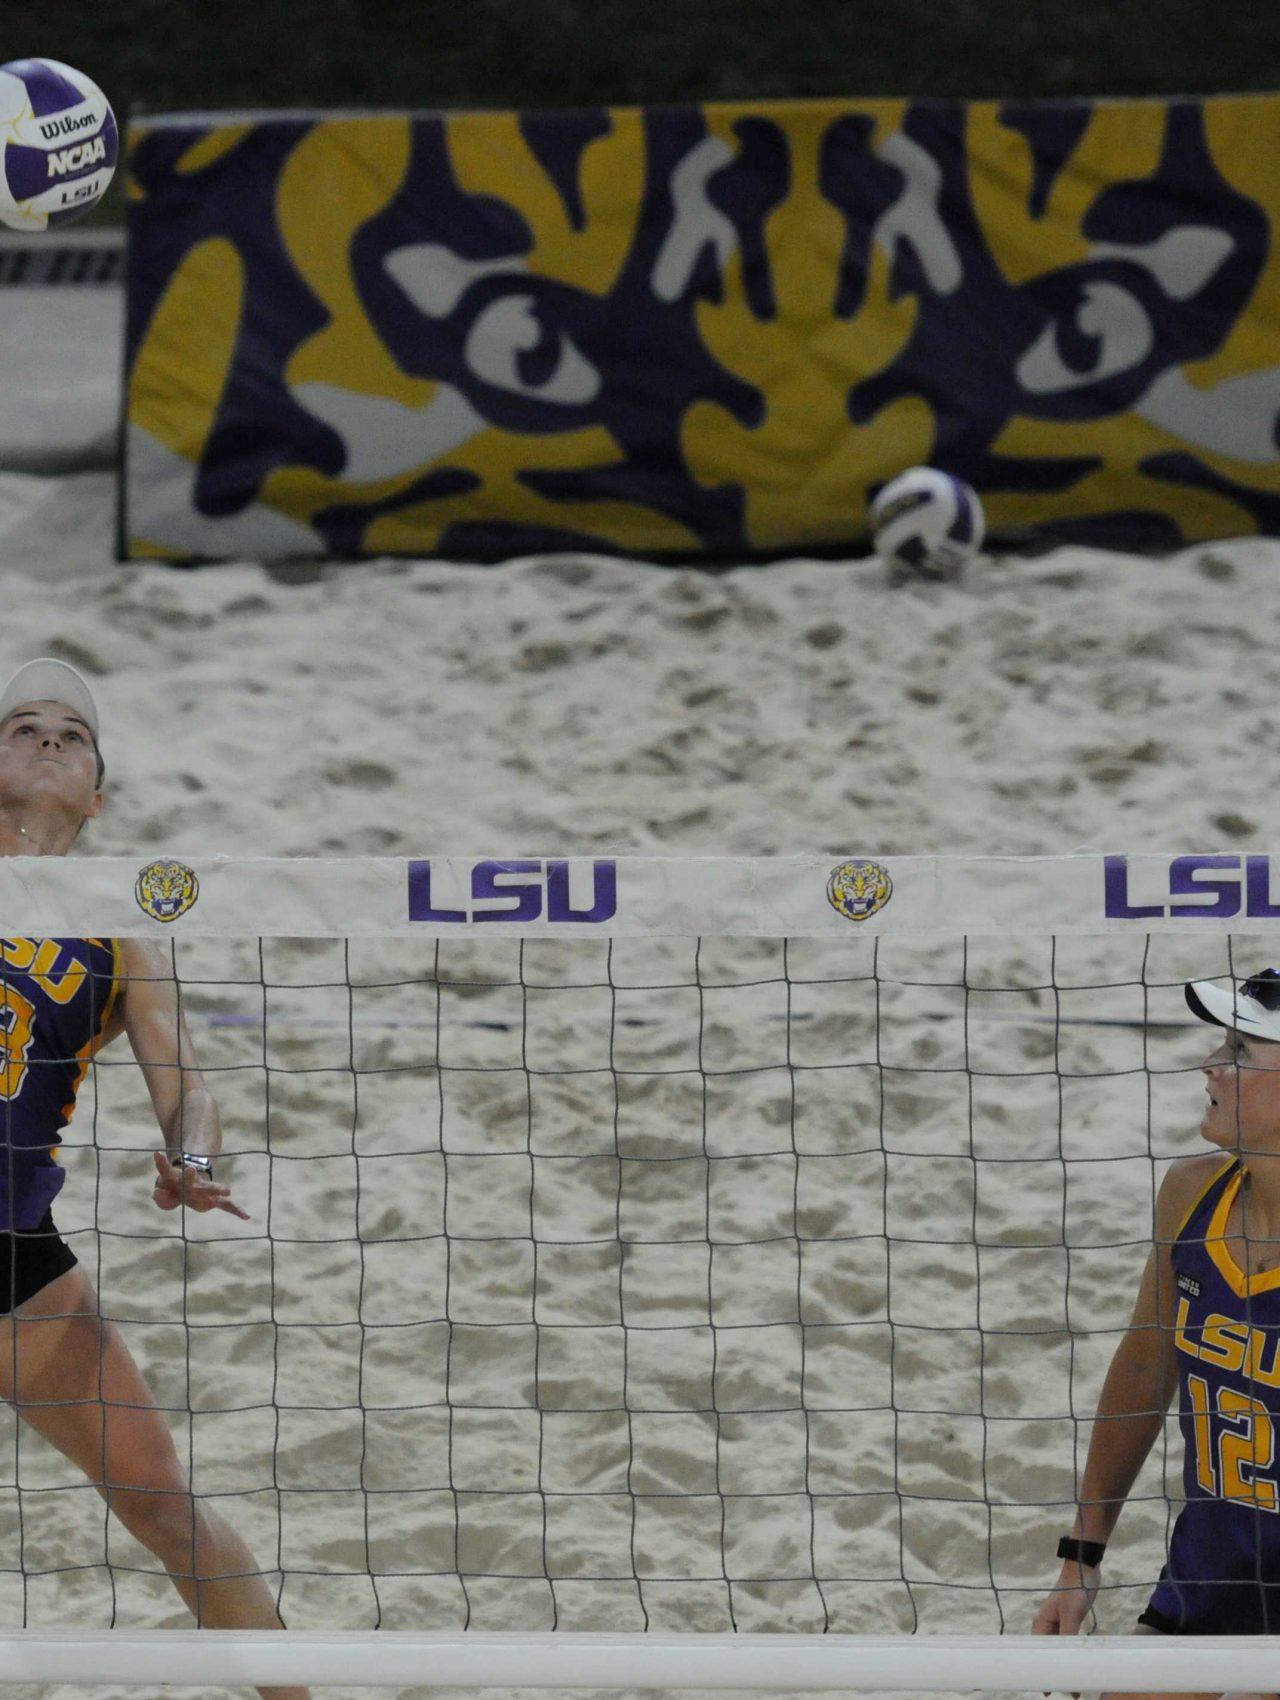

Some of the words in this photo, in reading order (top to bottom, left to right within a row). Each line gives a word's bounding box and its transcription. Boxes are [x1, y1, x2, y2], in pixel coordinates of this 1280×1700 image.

[40, 112, 97, 140] Wilson
[47, 136, 106, 178] NCAA
[61, 180, 100, 205] LSU
[408, 860, 617, 923] LSU
[1187, 1373, 1279, 1513] 12
